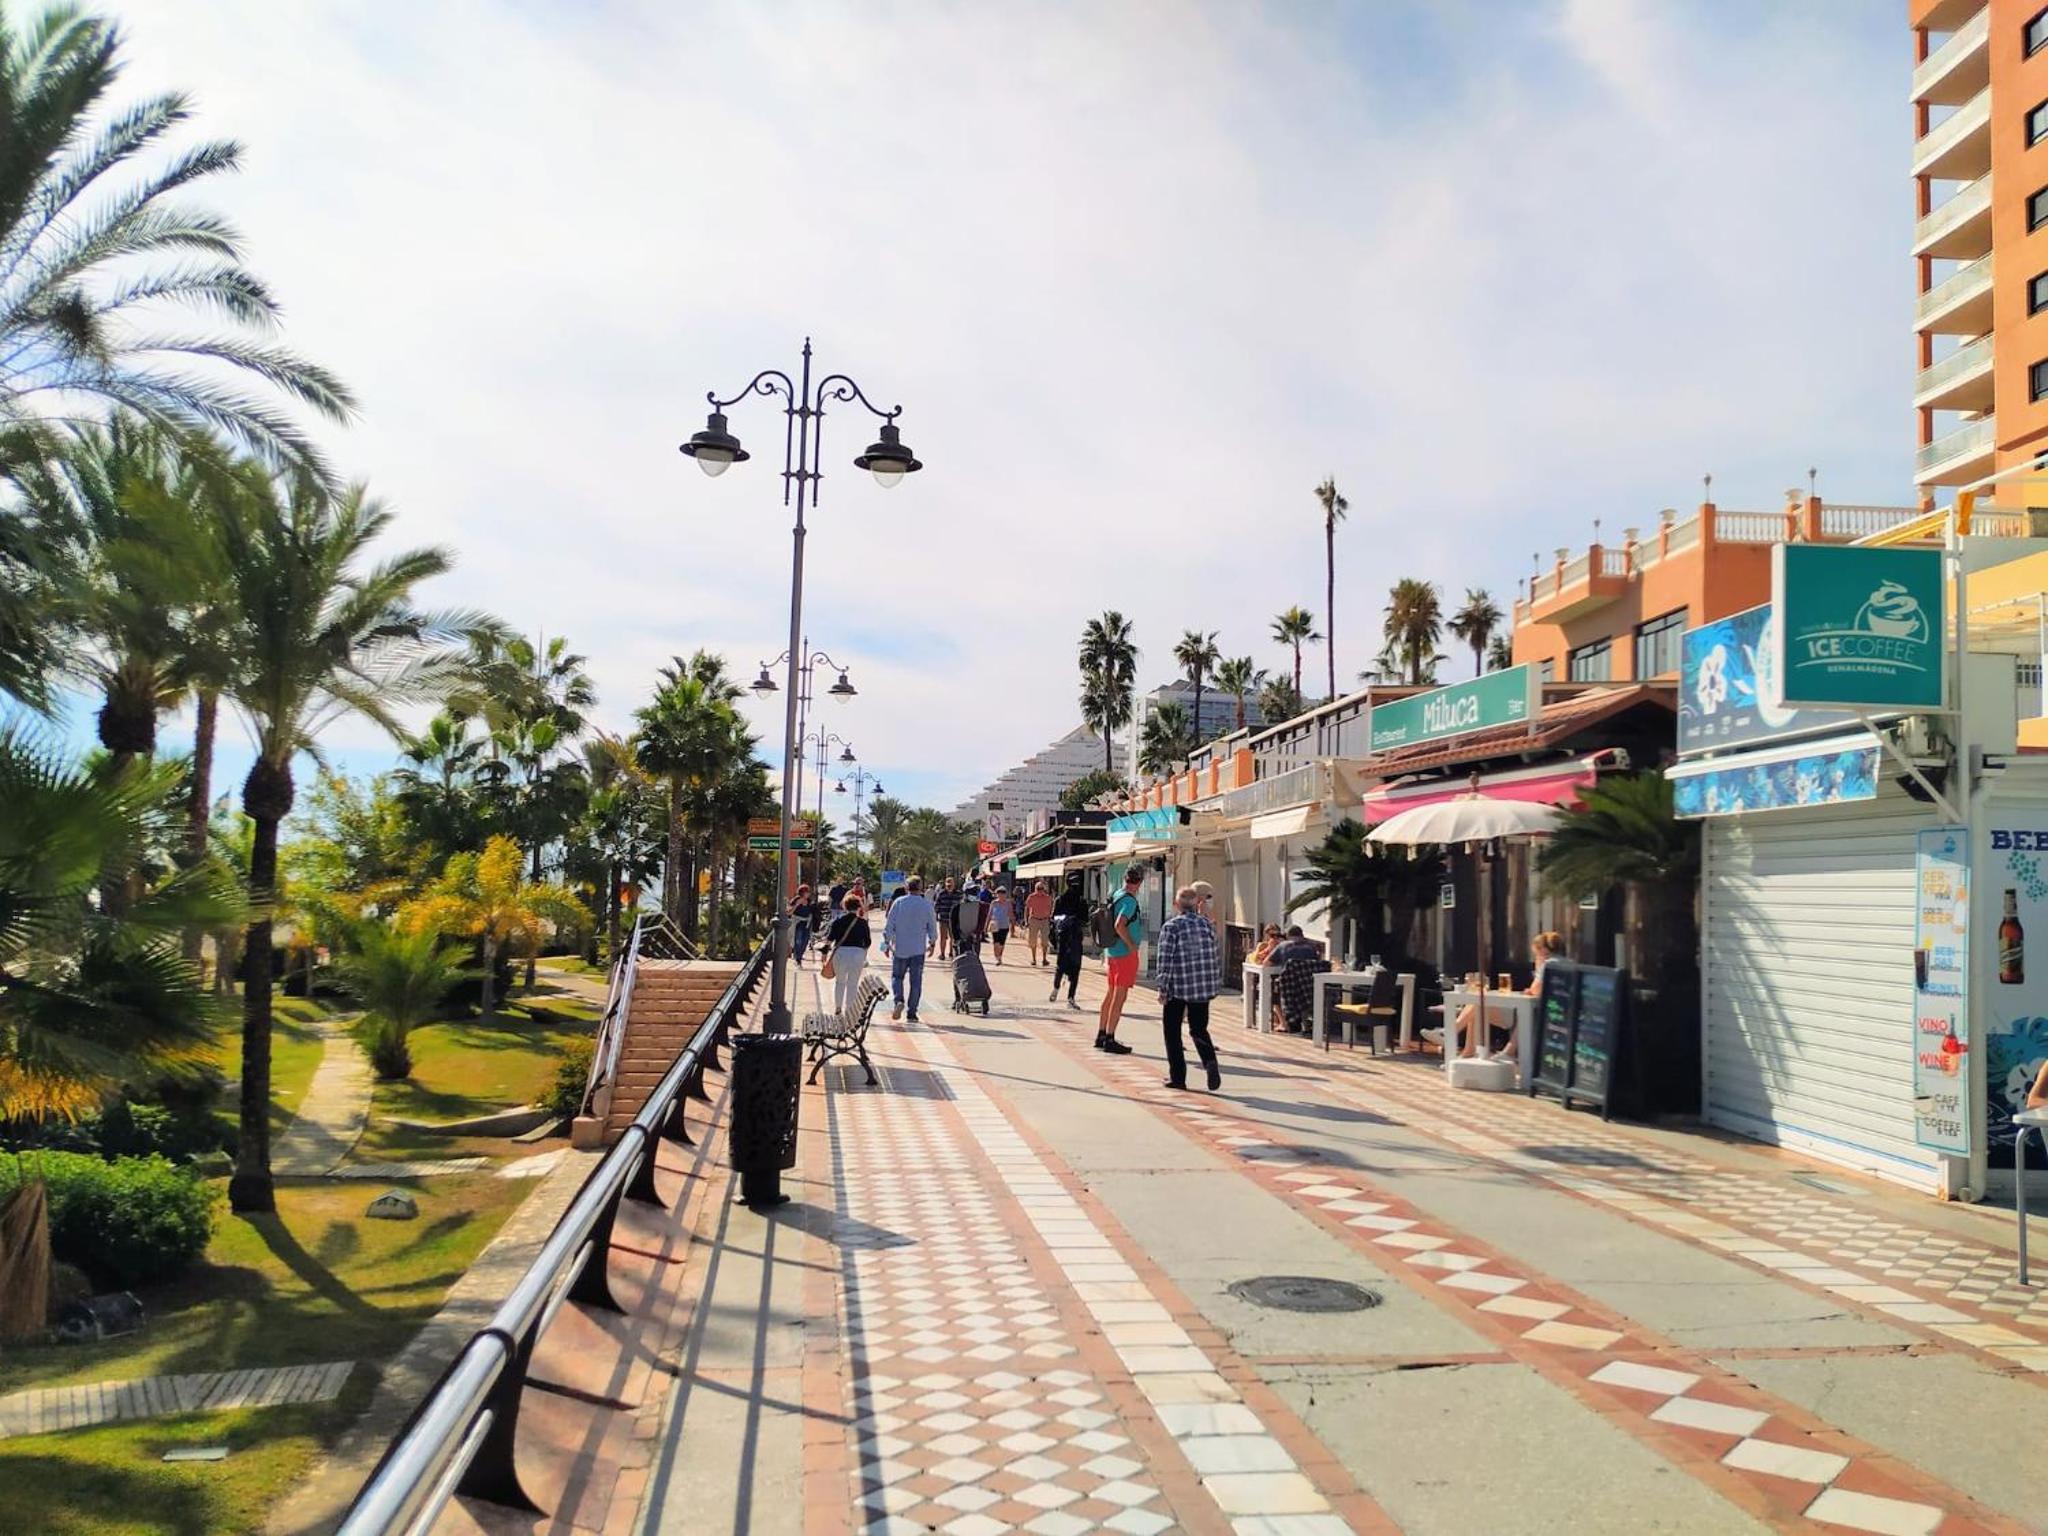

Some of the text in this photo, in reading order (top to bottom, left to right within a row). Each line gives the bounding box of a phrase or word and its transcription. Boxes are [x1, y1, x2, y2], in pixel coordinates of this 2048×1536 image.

[1422, 693, 1480, 735] Miluca
[1919, 1017, 1948, 1032] VINO
[1919, 1053, 1950, 1070] WINE
[1924, 1117, 1961, 1132] COFFEE
